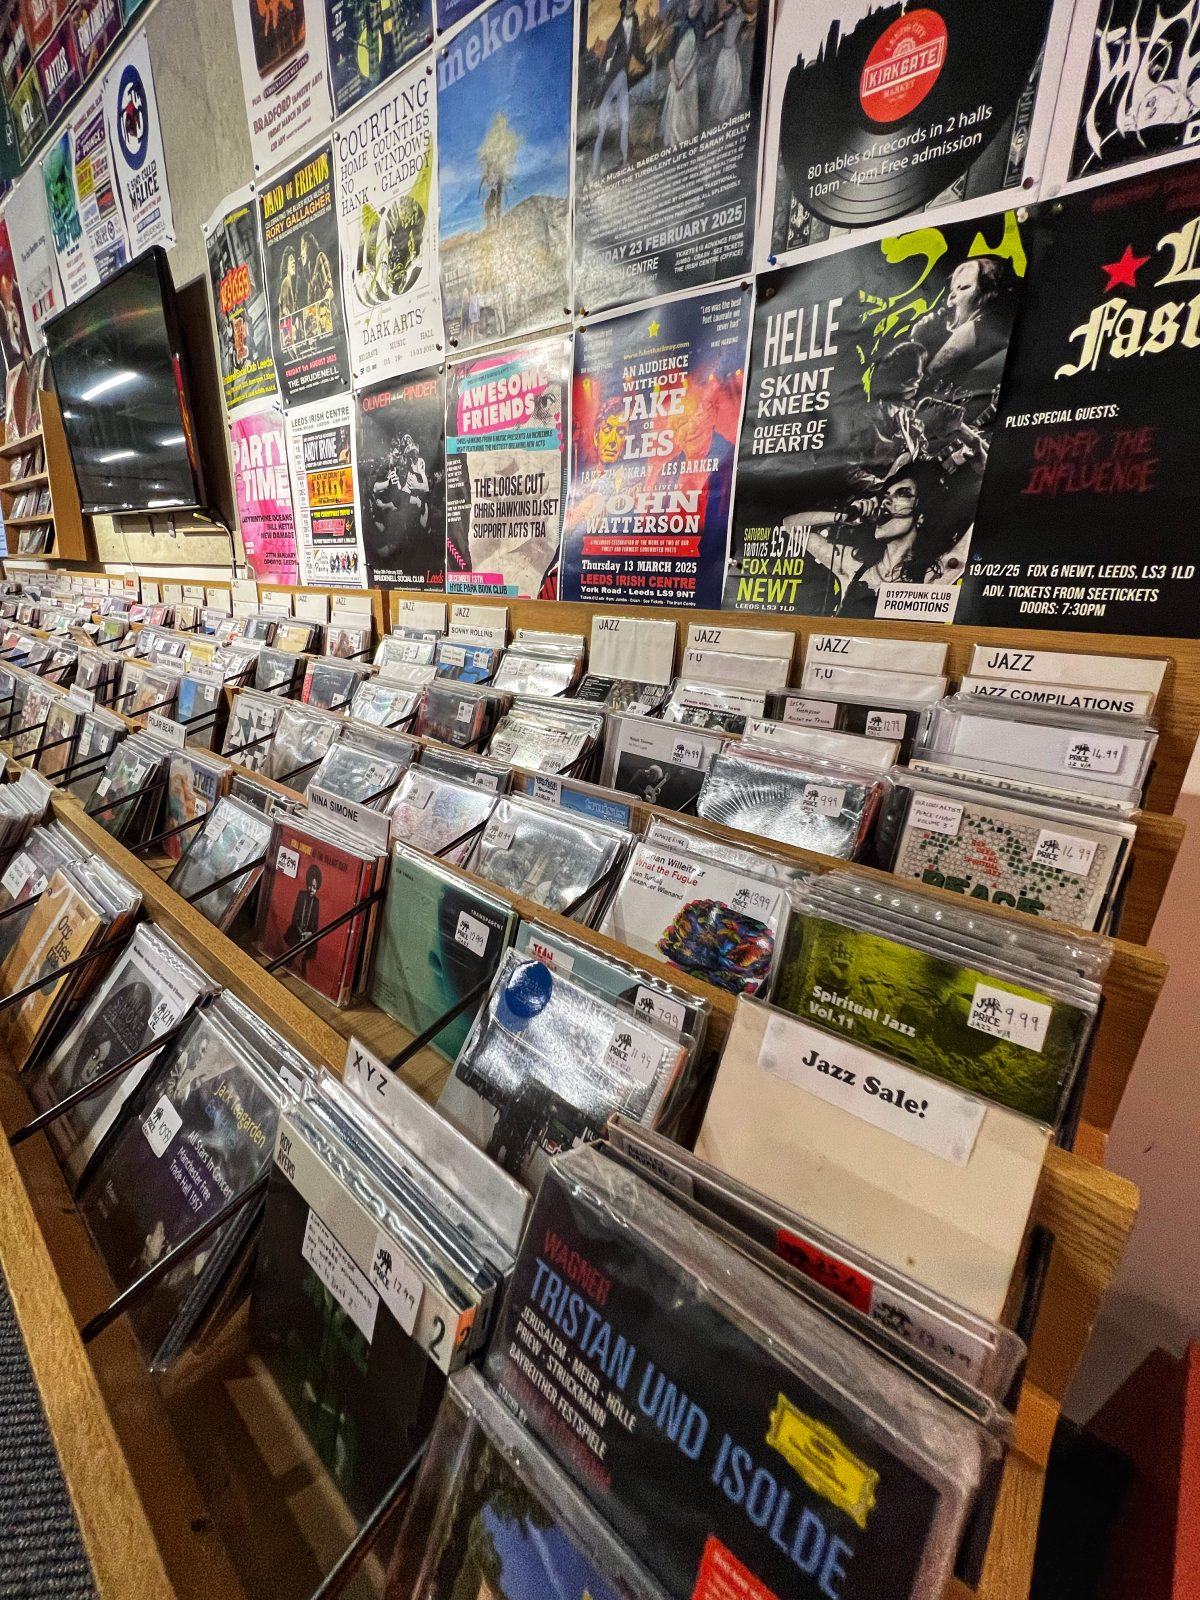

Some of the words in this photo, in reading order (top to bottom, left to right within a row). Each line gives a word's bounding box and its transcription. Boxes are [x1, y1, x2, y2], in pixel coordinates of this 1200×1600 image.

[869, 43, 938, 89] KIRKGATE
[253, 95, 292, 135] BRADFORD
[340, 78, 429, 162] COURTING
[341, 151, 368, 181] HOME
[373, 109, 430, 159] COUNTIES
[808, 163, 822, 180] 80
[824, 150, 860, 176] tables
[863, 142, 877, 162] of
[877, 128, 927, 155] records
[929, 123, 943, 139] in
[945, 117, 956, 133] 2
[958, 104, 992, 129] halls
[342, 178, 354, 198] NO
[374, 130, 430, 176] WINDOWS
[809, 178, 840, 199] 10am
[850, 169, 877, 188] 4pm
[881, 156, 909, 175] Free
[911, 130, 982, 166] admission
[129, 173, 159, 211] MALICE
[342, 187, 369, 216] HANK
[382, 151, 431, 191] GLADBOY
[265, 221, 284, 240] RORY
[286, 192, 331, 228] GALLAGHER
[629, 241, 642, 255] 23
[645, 217, 710, 251] FEBRUARY
[711, 205, 742, 229] 2025
[627, 257, 659, 276] CENTRE
[362, 319, 390, 345] DARK
[393, 309, 423, 336] ARTS
[763, 297, 843, 368] HELLE
[622, 365, 637, 379] AN
[638, 355, 689, 375] AUDIENCE
[462, 368, 548, 411] AWESOME
[622, 372, 688, 392] WITHOUT
[759, 366, 834, 399] SKINT
[291, 418, 309, 428] LEEDS
[309, 413, 325, 423] IRISH
[325, 406, 350, 420] CENTRE
[462, 392, 535, 432] FRIENDS
[619, 387, 687, 422] JAKE
[757, 391, 831, 419] KNEES
[1005, 414, 1030, 428] PLUS
[1032, 409, 1073, 426] SPECIAL
[1075, 404, 1120, 421] GUESTS:
[753, 422, 801, 439] QUEER
[806, 419, 828, 433] OF
[231, 431, 286, 472] PARTY
[623, 430, 674, 460] LES
[752, 433, 825, 455] HEARTS
[661, 462, 678, 475] LES
[680, 458, 719, 472] BARKER
[242, 465, 289, 501] TIME
[474, 478, 491, 498] THE
[493, 475, 523, 497] LOOSE
[525, 473, 545, 495] CUT
[474, 503, 495, 519] CHRIS
[496, 501, 531, 518] HAWKINS
[532, 500, 543, 516] DJ
[543, 499, 559, 516] SET
[473, 522, 507, 539] SUPPORT
[508, 522, 528, 538] ACTS
[530, 521, 546, 538] TBA
[586, 515, 700, 534] WATTERSON
[743, 527, 772, 541] SATURDAY
[770, 526, 785, 558] £5
[785, 525, 812, 558] ADV
[582, 560, 621, 573] Thursday
[624, 561, 633, 571] 13
[637, 561, 672, 573] MARCH
[675, 562, 697, 573] 2025
[741, 559, 768, 576] FOX
[772, 559, 804, 576] AND
[969, 564, 1020, 577] 19/02/25
[1027, 565, 1048, 577] FOX
[1051, 565, 1058, 577] &
[1059, 565, 1095, 580] NEWT,
[1098, 565, 1138, 580] LEEDS,
[1142, 566, 1166, 579] LS3
[1171, 566, 1195, 579] 1LD
[449, 583, 463, 592] HYDE
[463, 584, 477, 593] PARK
[478, 584, 493, 594] BOOK
[493, 585, 508, 594] CLUB
[581, 573, 613, 585] LEEDS
[616, 575, 645, 587] IRISH
[649, 576, 696, 589] CENTRE
[602, 586, 621, 594] Road
[629, 588, 654, 596] Leeds
[737, 578, 802, 604] NEWT
[982, 585, 1005, 598] ADV.
[1008, 585, 1051, 599] TICKETS
[1052, 586, 1085, 600] FROM
[1087, 587, 1159, 602] SEETICKETS
[883, 600, 949, 613] PROMOTIONS
[886, 590, 929, 600] 01977PUNK
[930, 591, 952, 601] CLUB
[455, 608, 470, 618] JAZZ
[1020, 602, 1059, 615] DOORS:
[1061, 603, 1106, 617] 7:30PM
[451, 626, 469, 635] SONNY
[470, 629, 493, 638] ROLLINS
[598, 619, 620, 632] JAZZ
[694, 630, 720, 644] JAZZ
[815, 637, 850, 655] JAZZ
[814, 667, 833, 681] T,U
[987, 651, 1035, 673] JAZZ
[161, 722, 174, 736] BEAR
[1069, 754, 1090, 763] PRICE
[311, 792, 328, 807] NINA
[329, 800, 359, 823] SIMONE
[1037, 850, 1059, 862] PRICE
[471, 909, 503, 931] TRANSPARENT
[809, 1000, 854, 1030] Vol.11
[812, 985, 878, 1022] Spiritual
[881, 1013, 917, 1039] Jazz
[971, 1010, 1001, 1028] PRICE
[610, 1045, 628, 1061] PRICE
[801, 1049, 856, 1086] Jazz
[862, 1075, 929, 1119] Sale!
[231, 1098, 266, 1149] Teagarden
[279, 1132, 292, 1153] ROY
[178, 1146, 201, 1187] Manchester
[198, 1182, 211, 1202] Free
[277, 1153, 296, 1180] AYERS
[169, 1159, 184, 1182] Trade
[180, 1178, 192, 1197] Hall
[189, 1191, 203, 1213] 1957
[374, 1261, 390, 1291] PRICE
[545, 1231, 612, 1306] WAGNER
[429, 1315, 445, 1361] 2
[521, 1306, 567, 1361] JERUSALEM
[571, 1356, 600, 1395] MEIER
[516, 1320, 542, 1356] PRIEW
[546, 1356, 607, 1427] STRUCKMANN
[509, 1341, 558, 1405] BAYREUTHER
[558, 1396, 608, 1460] FESTSPIELE
[530, 1257, 637, 1391] TRISTAN
[638, 1363, 710, 1461] UND
[711, 1434, 855, 1600] ISOLDE
